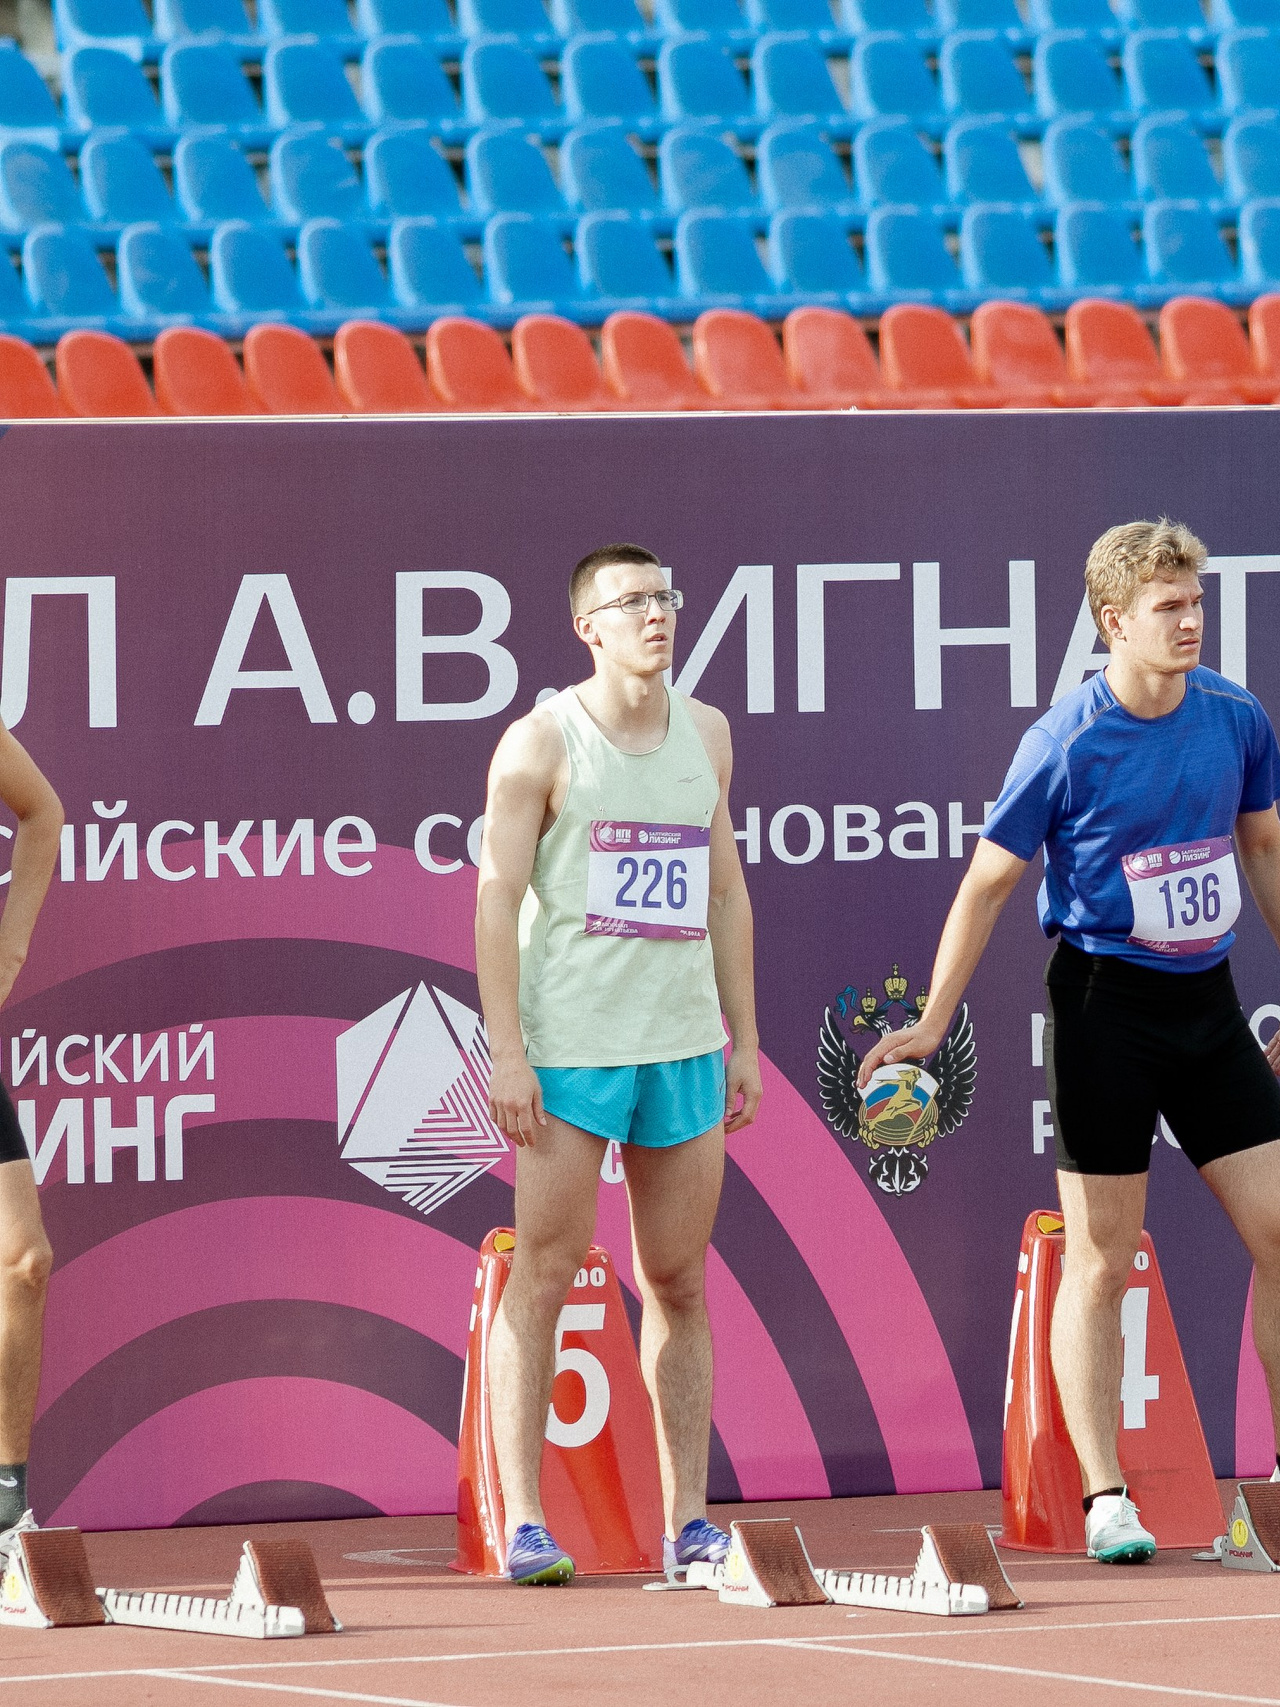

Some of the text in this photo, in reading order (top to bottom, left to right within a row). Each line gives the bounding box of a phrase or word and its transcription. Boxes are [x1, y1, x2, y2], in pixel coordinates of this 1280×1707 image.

[0, 800, 377, 893] йские
[615, 856, 688, 910] 226
[1158, 872, 1221, 929] 136
[11, 1023, 215, 1087] ЙСКИЙ
[17, 1093, 216, 1186] ИНГ
[545, 1302, 611, 1448] 5
